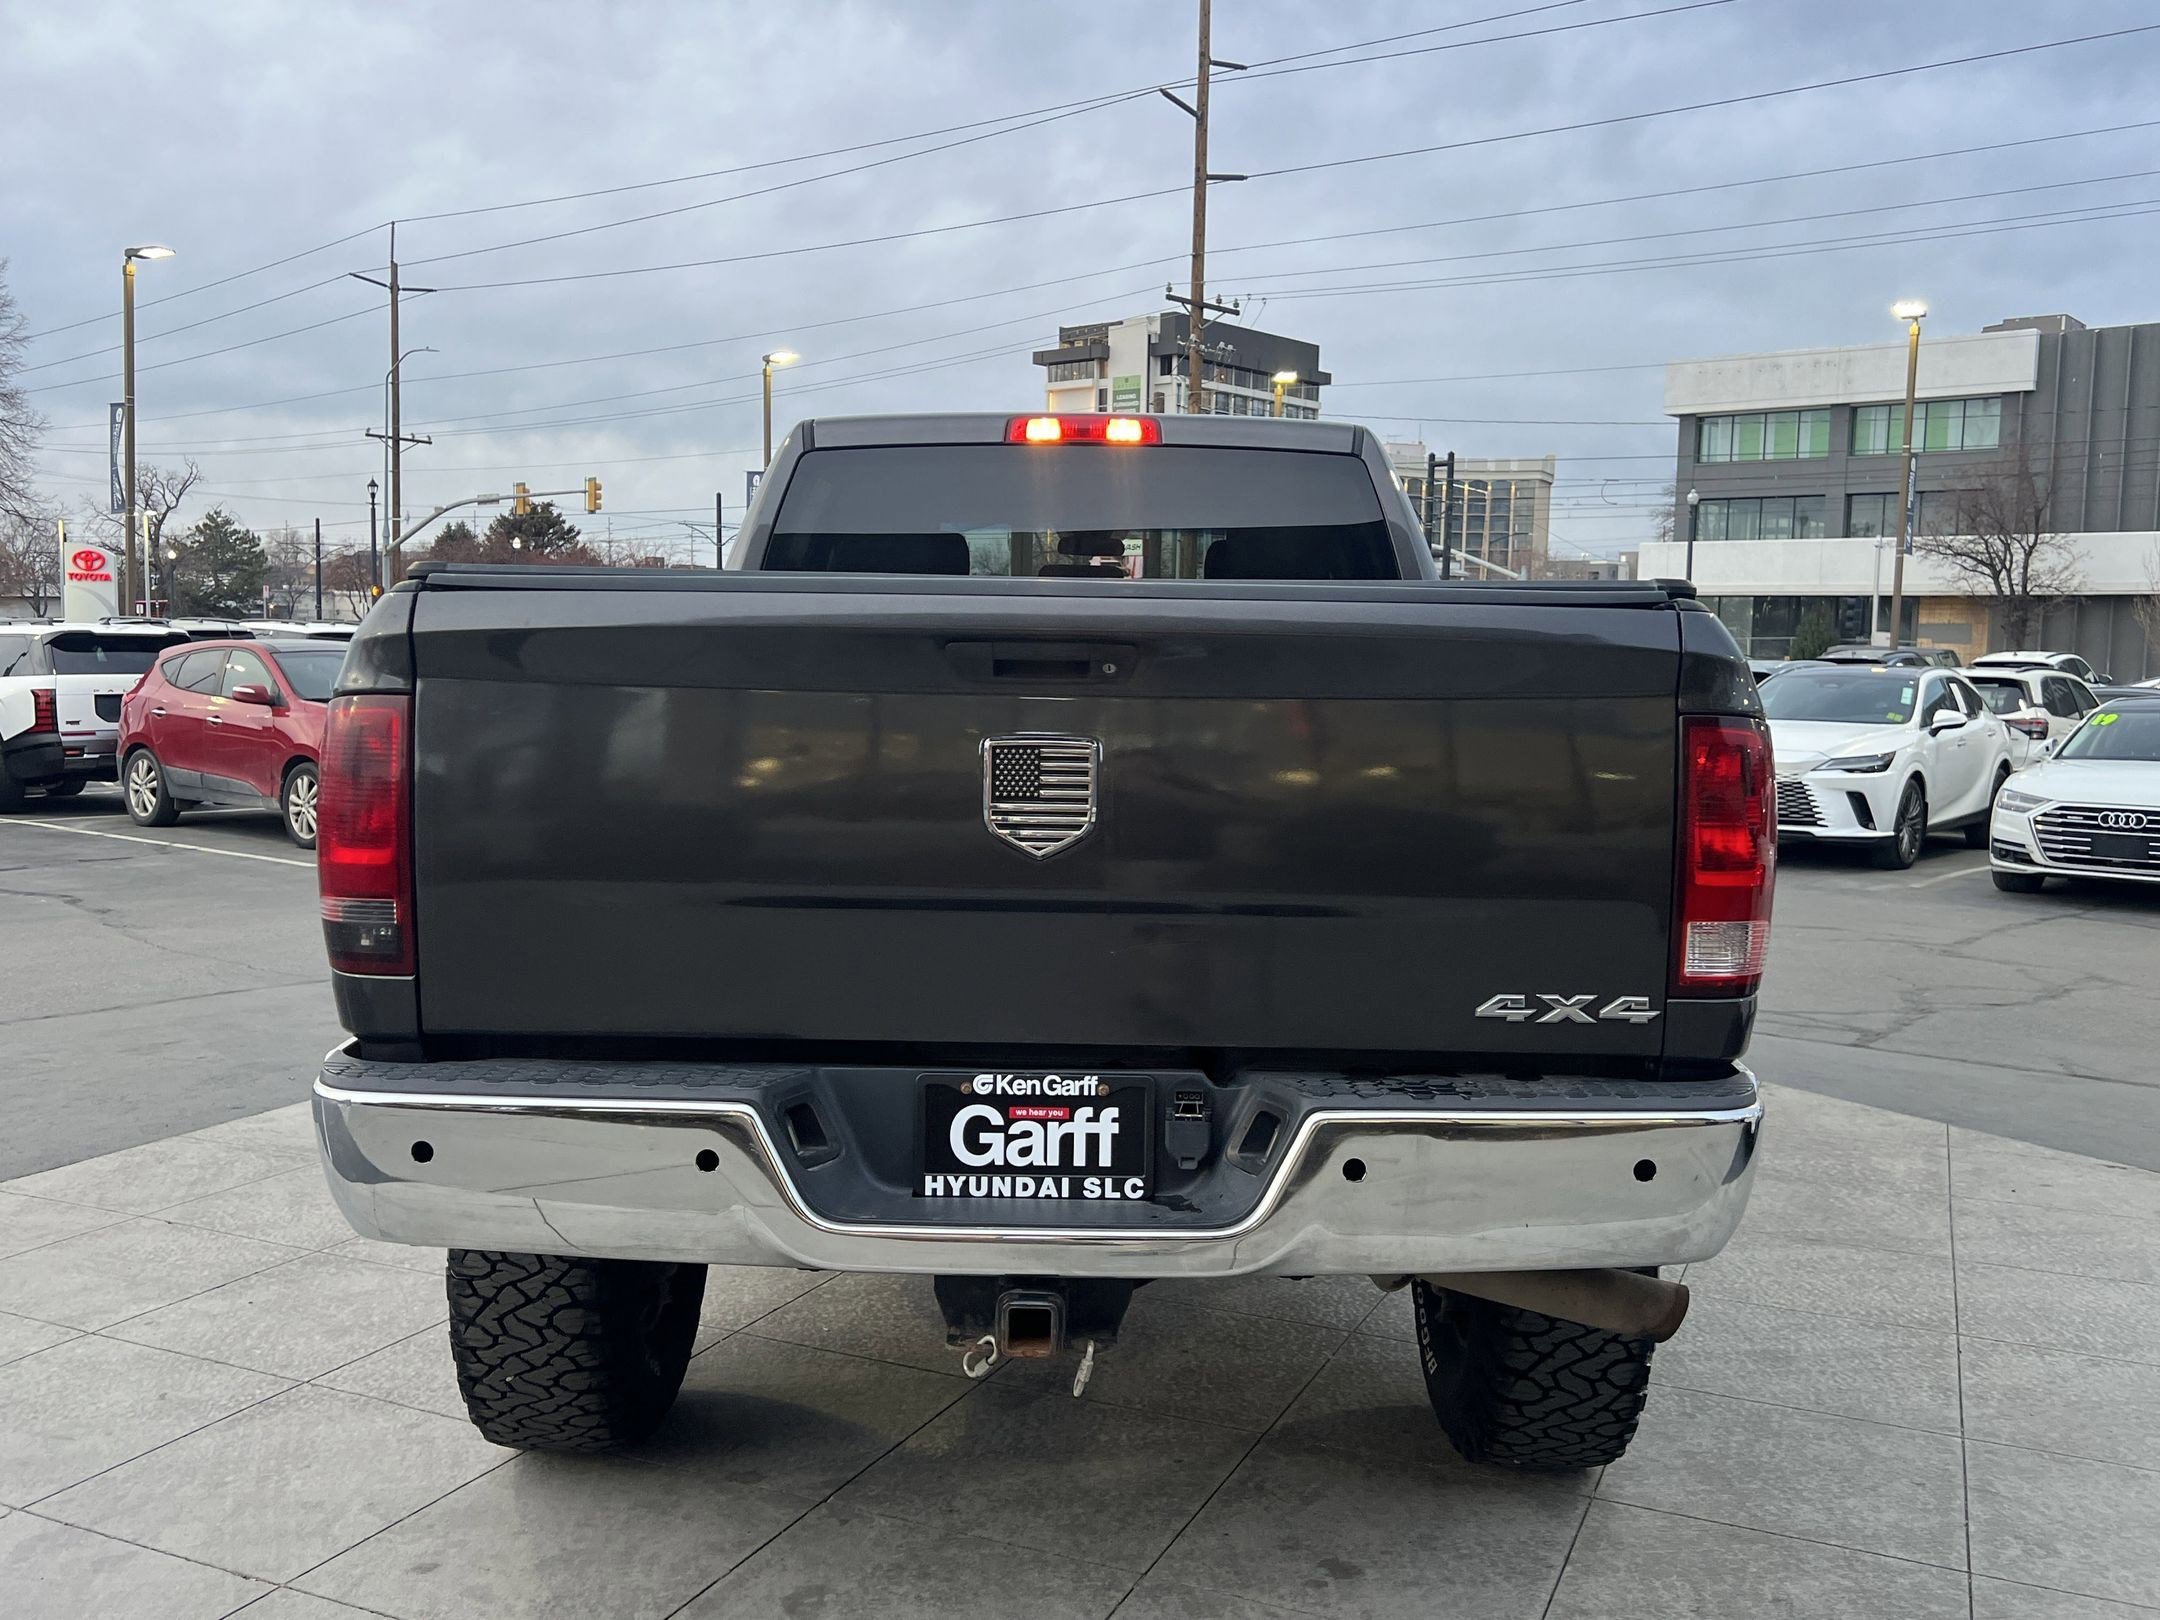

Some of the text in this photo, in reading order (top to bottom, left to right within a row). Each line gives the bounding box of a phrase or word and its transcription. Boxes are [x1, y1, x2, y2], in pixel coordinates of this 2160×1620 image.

[67, 572, 112, 582] TOYOTA
[2091, 713, 2119, 726] 19
[1475, 993, 1662, 1024] 4X4
[996, 1074, 1099, 1096] Ken Garff
[1028, 1108, 1047, 1116] hear
[1048, 1109, 1063, 1118] you
[950, 1104, 1120, 1167] Garff
[924, 1175, 1145, 1199] HYUNDAI SLC
